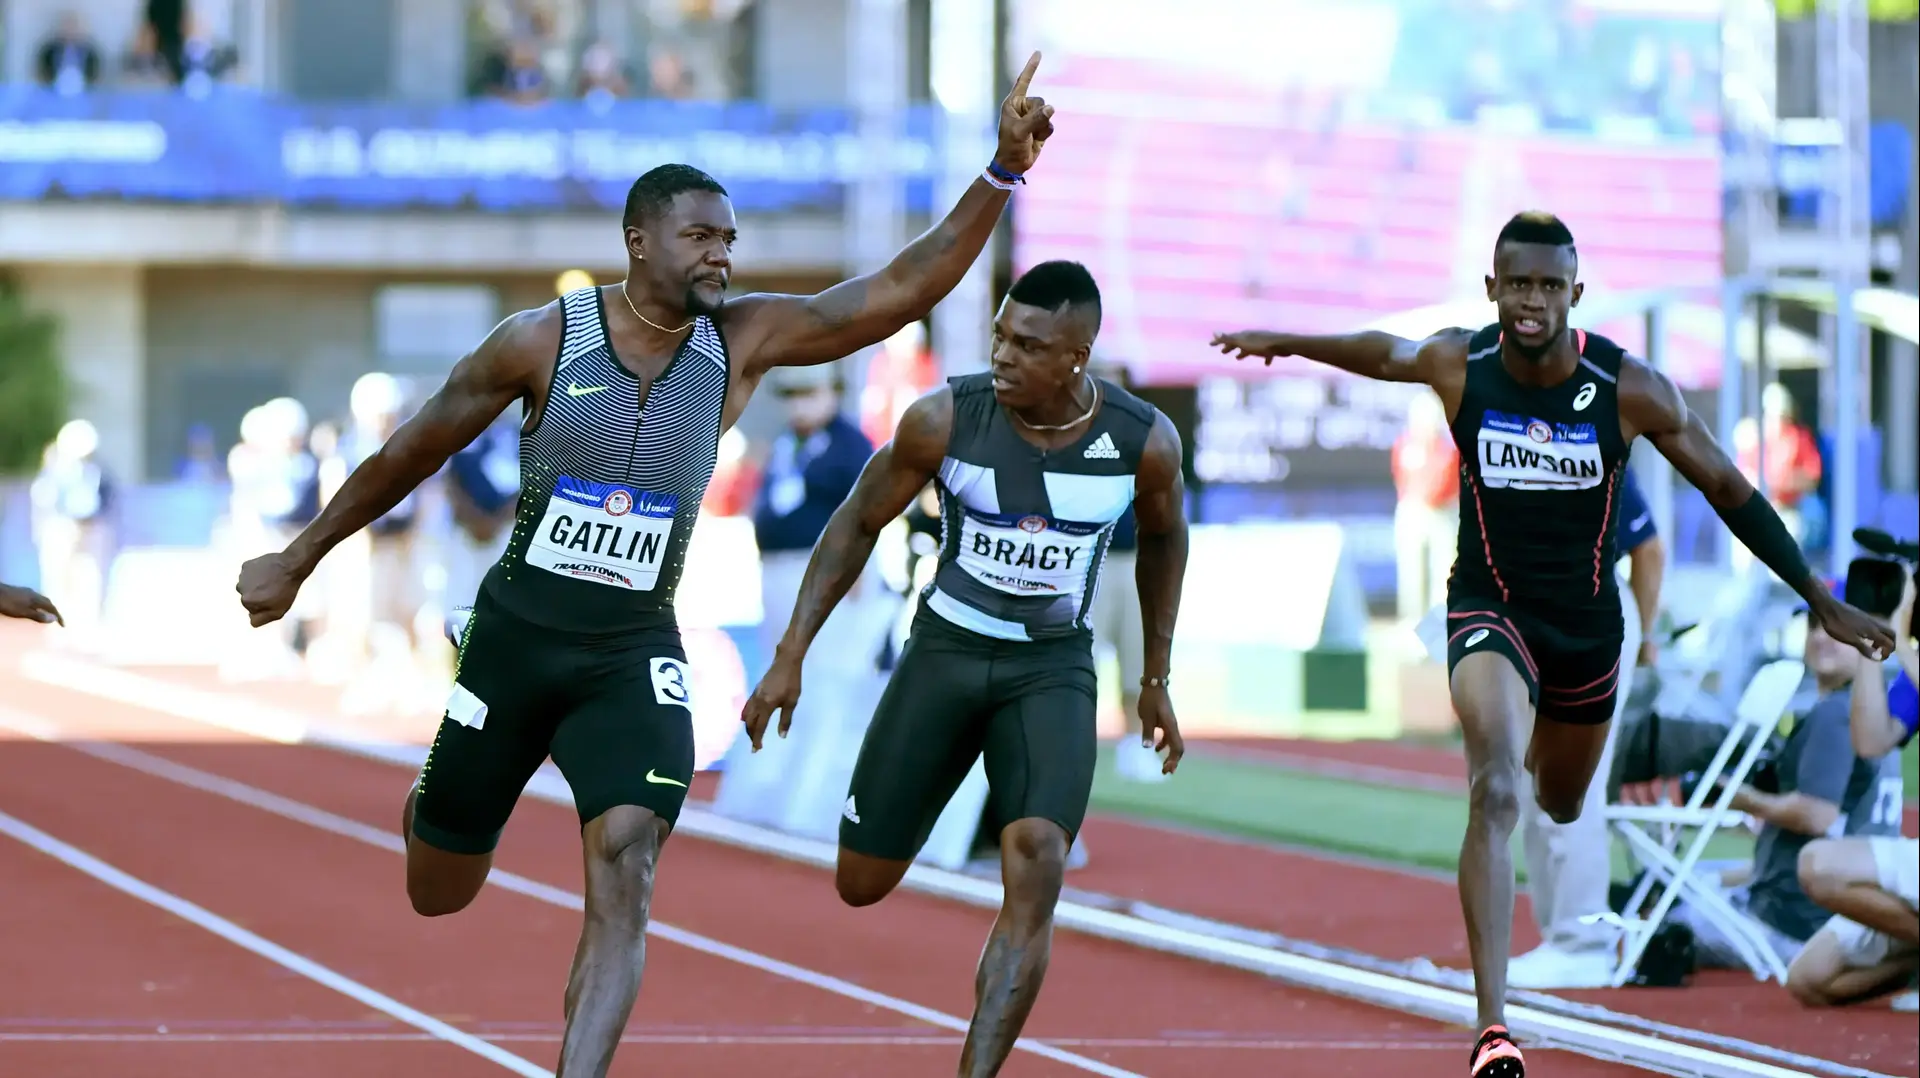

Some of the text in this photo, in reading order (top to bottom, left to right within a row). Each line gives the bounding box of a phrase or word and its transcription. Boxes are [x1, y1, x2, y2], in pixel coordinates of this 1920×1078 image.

[1485, 440, 1598, 478] LAWSON
[650, 505, 672, 513] USATF
[549, 514, 662, 564] GATLIN
[972, 531, 1081, 571] BRACY
[658, 661, 689, 703] 3
